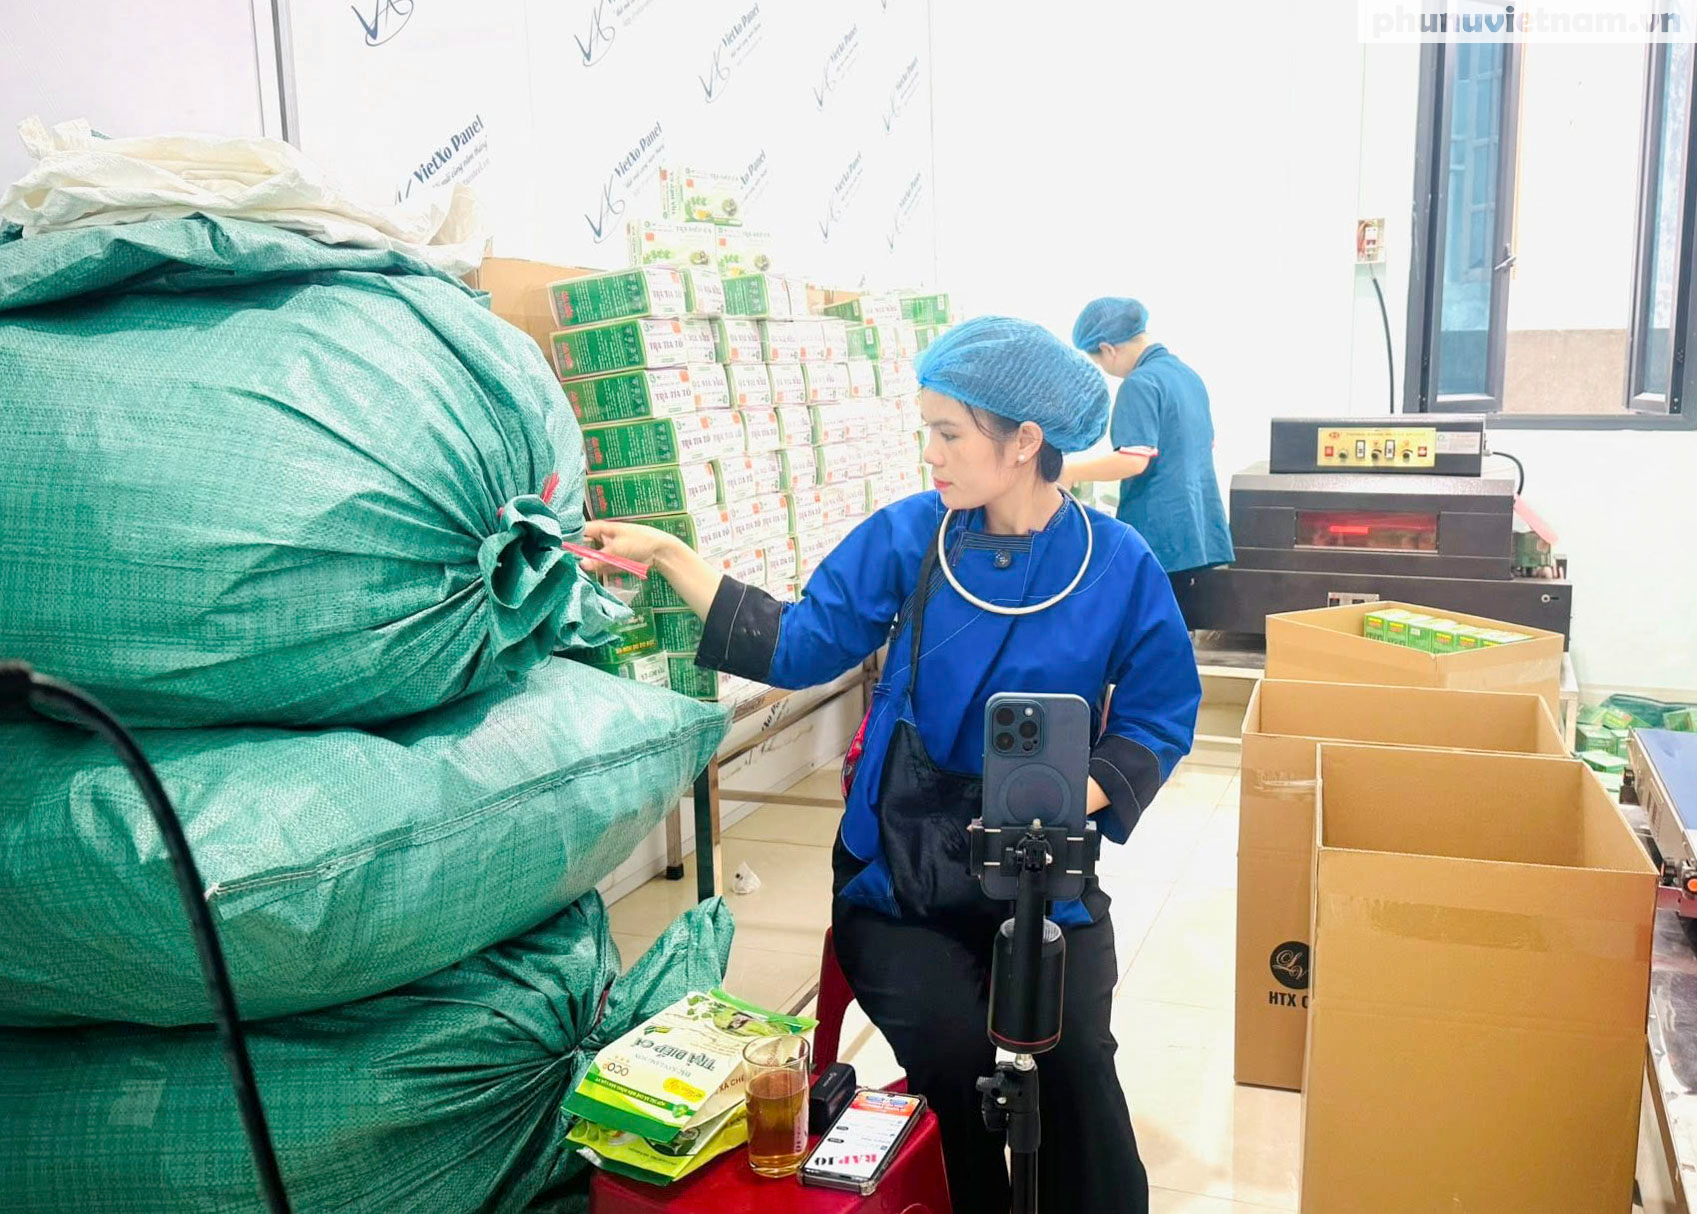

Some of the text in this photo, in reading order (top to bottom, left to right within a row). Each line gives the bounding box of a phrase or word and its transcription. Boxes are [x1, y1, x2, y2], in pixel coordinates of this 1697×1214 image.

[413, 146, 453, 184] VietXo
[450, 114, 484, 152] Panel
[1269, 991, 1297, 1007] HTX
